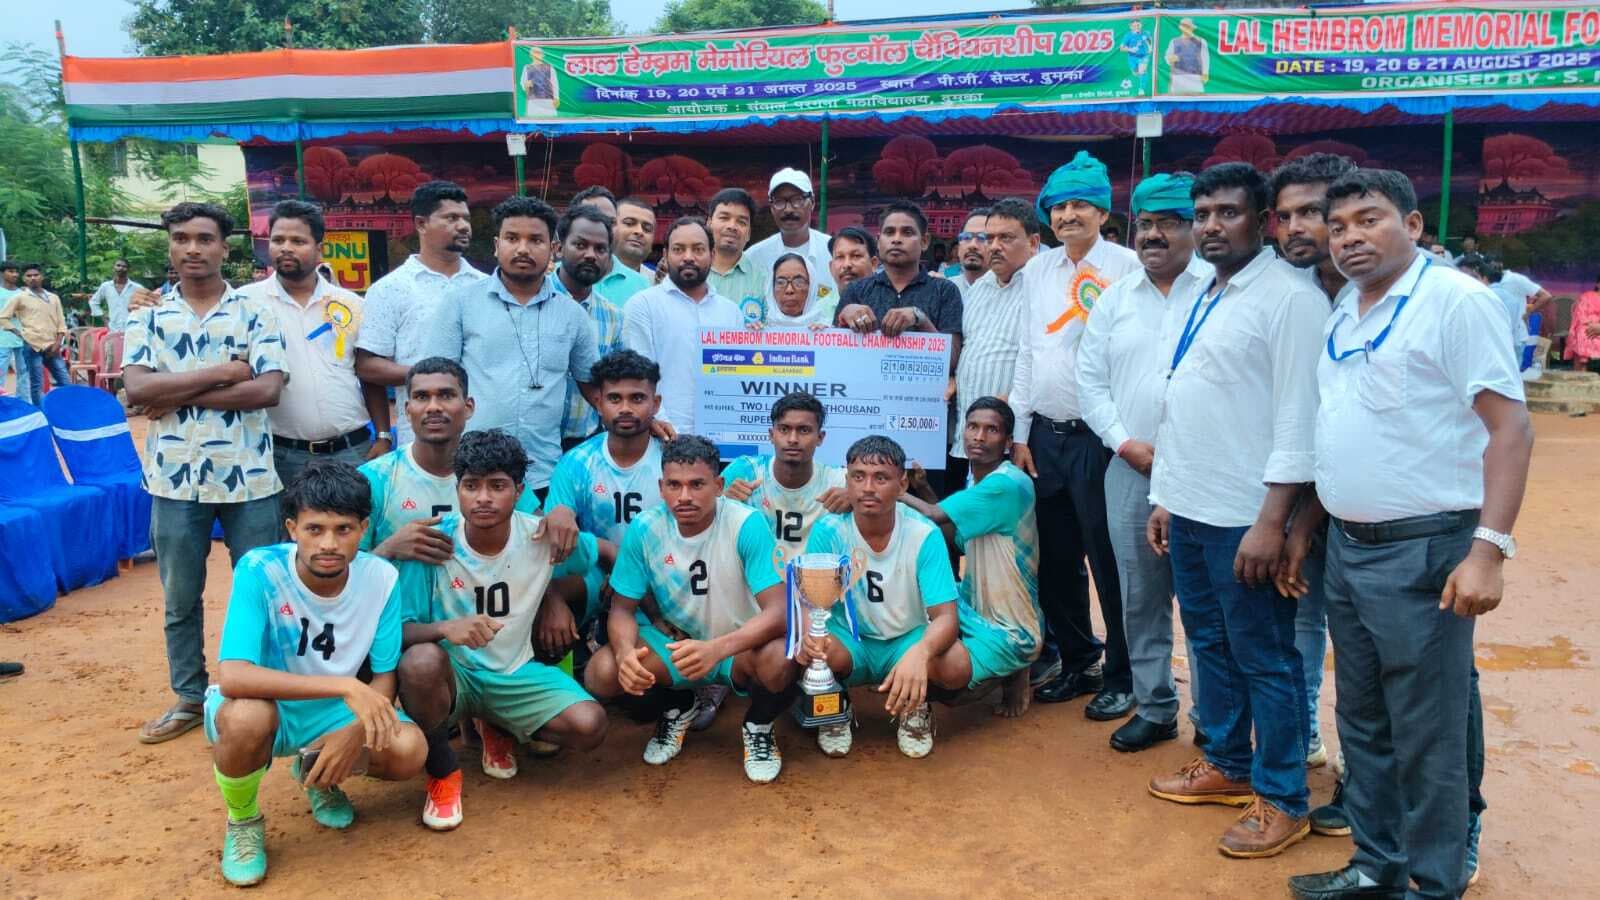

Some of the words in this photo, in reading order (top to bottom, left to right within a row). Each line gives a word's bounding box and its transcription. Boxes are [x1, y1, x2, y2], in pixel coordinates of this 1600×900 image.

[1218, 19, 1267, 55] LAL
[1272, 15, 1407, 54] HEMBROM
[1412, 10, 1557, 52] MEMORIAL
[1562, 9, 1600, 46] FO
[562, 54, 620, 76] लाल
[695, 39, 814, 72] मेमोरियल
[815, 34, 910, 77] फुटबॉल
[1059, 28, 1115, 54] 2025
[1275, 60, 1326, 74] DATE
[1342, 59, 1370, 74] 19,
[1375, 58, 1400, 71] 20
[1408, 58, 1421, 70] &
[1426, 57, 1447, 70] 21
[1452, 54, 1533, 70] AUGUST
[1538, 52, 1591, 68] 2025
[648, 88, 671, 99] 19,
[678, 87, 699, 98] 20
[734, 86, 755, 96] 21
[763, 83, 808, 95] अगस्त
[814, 80, 858, 91] 2025
[1040, 69, 1085, 84] दुमका
[1361, 73, 1500, 89] ORGANISED
[1507, 72, 1541, 85] BY
[321, 241, 367, 259] ONU
[338, 262, 369, 289] J
[701, 331, 717, 345] LAL
[719, 331, 762, 345] HEMBROM
[766, 332, 811, 346] MEMORIAL
[813, 333, 858, 348] FOOTBALL
[861, 334, 926, 350] CHAMPIONSHIP
[741, 380, 848, 397] WINNER
[740, 402, 763, 411] TWO
[825, 403, 881, 414] THOUSAND
[740, 415, 772, 424] RUPEE
[613, 491, 642, 524] 16
[776, 509, 803, 542] 12
[689, 559, 709, 595] 2
[866, 570, 884, 603] 6
[474, 581, 510, 618] 10
[297, 617, 336, 661] 14
